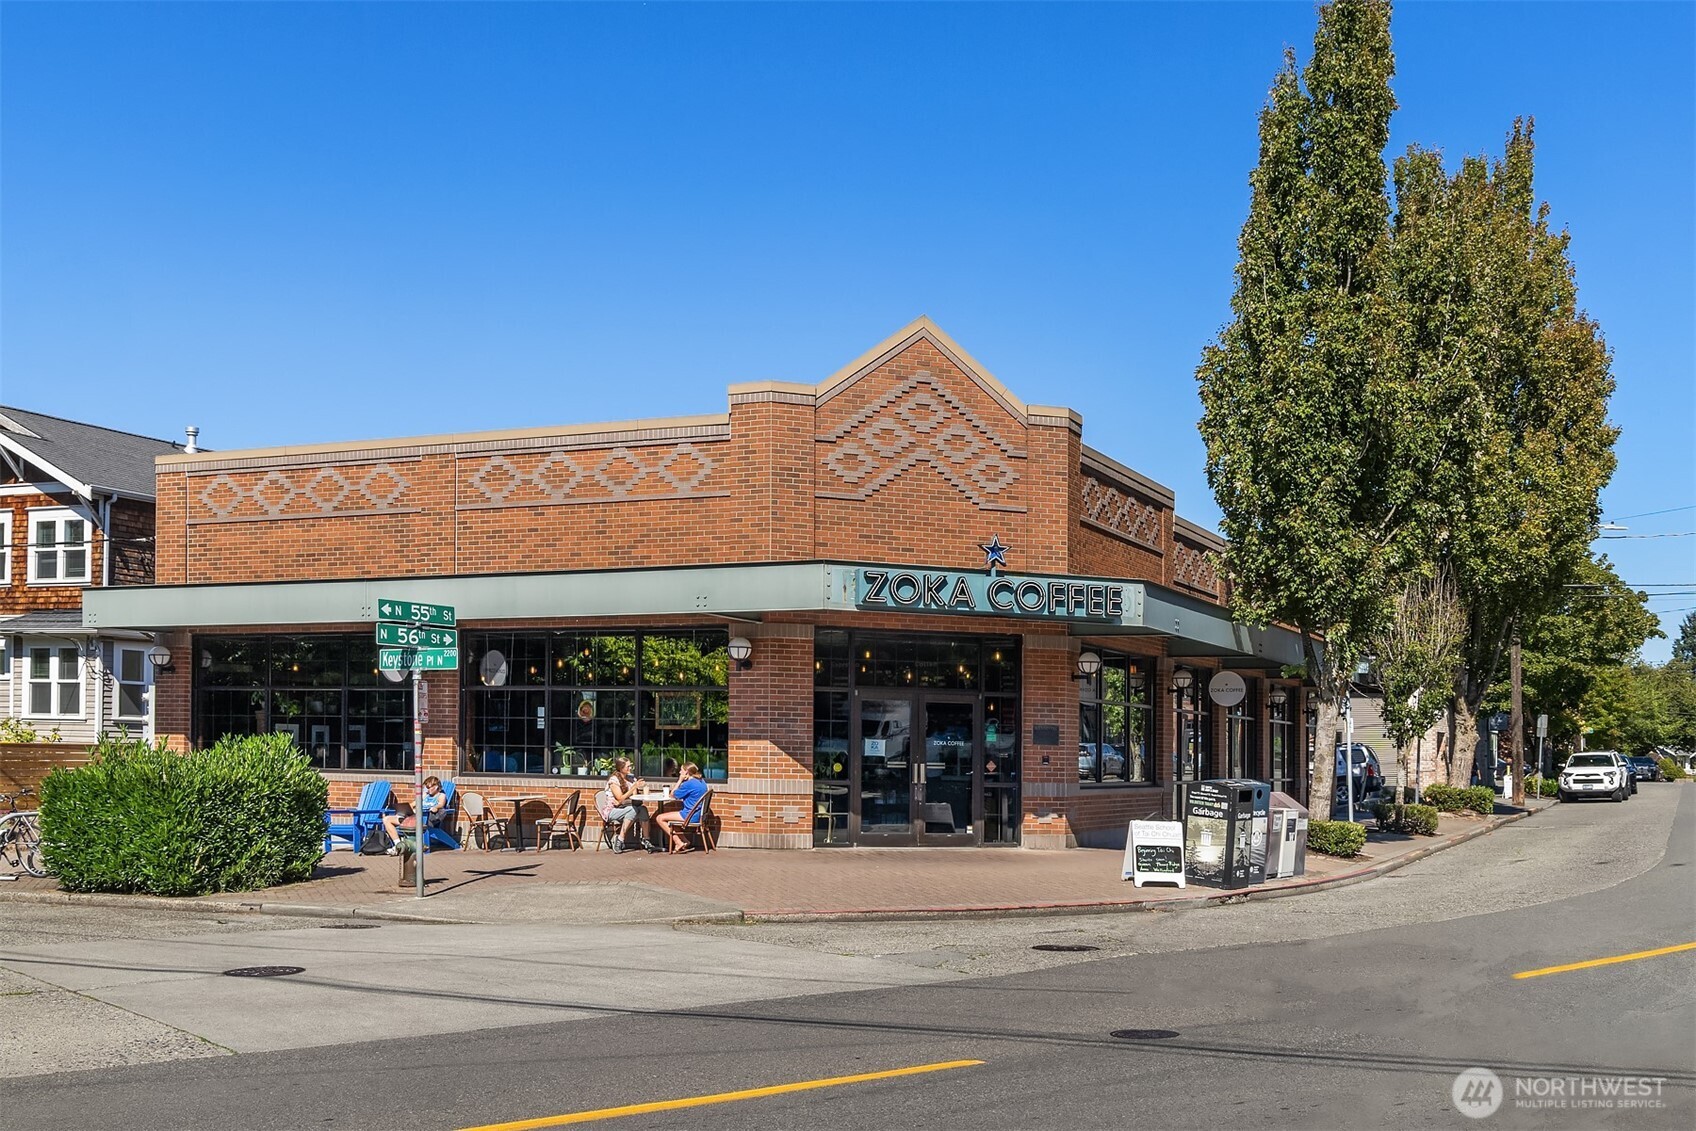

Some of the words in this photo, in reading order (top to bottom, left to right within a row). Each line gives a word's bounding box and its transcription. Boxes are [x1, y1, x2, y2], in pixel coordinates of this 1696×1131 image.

[864, 571, 976, 608] ZOKA
[988, 577, 1124, 616] COFFEE
[395, 606, 402, 616] N
[411, 604, 436, 621] 55th
[443, 610, 452, 621] St
[380, 629, 388, 639] N
[398, 628, 426, 644] 56th
[431, 634, 440, 643] St
[382, 652, 422, 668] Keystone
[426, 655, 434, 666] Pl
[437, 656, 443, 666] N
[1193, 806, 1223, 818] Garbage
